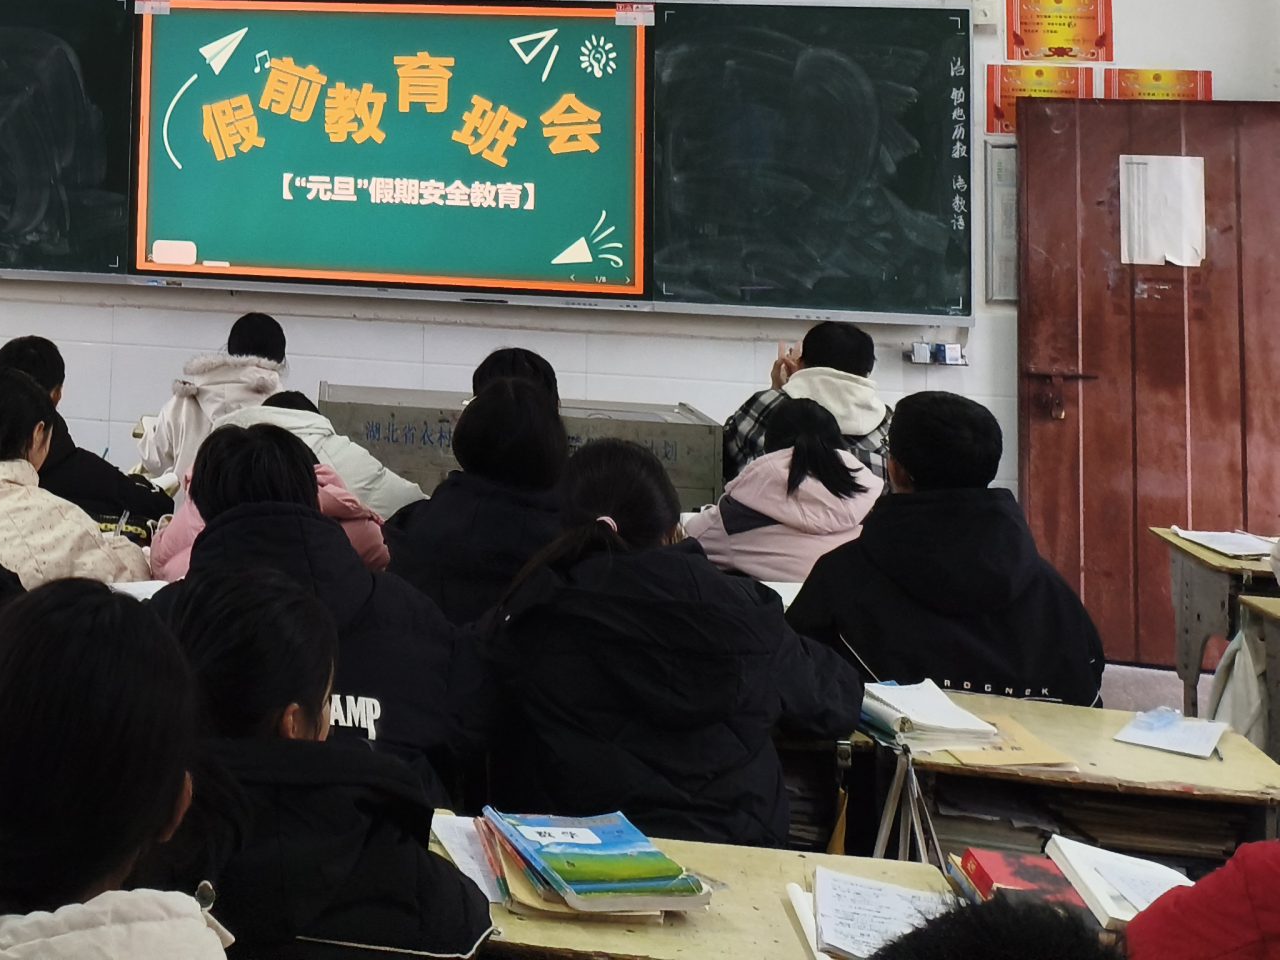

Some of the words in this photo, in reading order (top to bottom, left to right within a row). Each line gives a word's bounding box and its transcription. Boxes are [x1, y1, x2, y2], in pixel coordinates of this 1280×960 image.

[201, 51, 601, 167] 假前教育班会
[281, 172, 537, 210] 【“元旦”假期安全教育】
